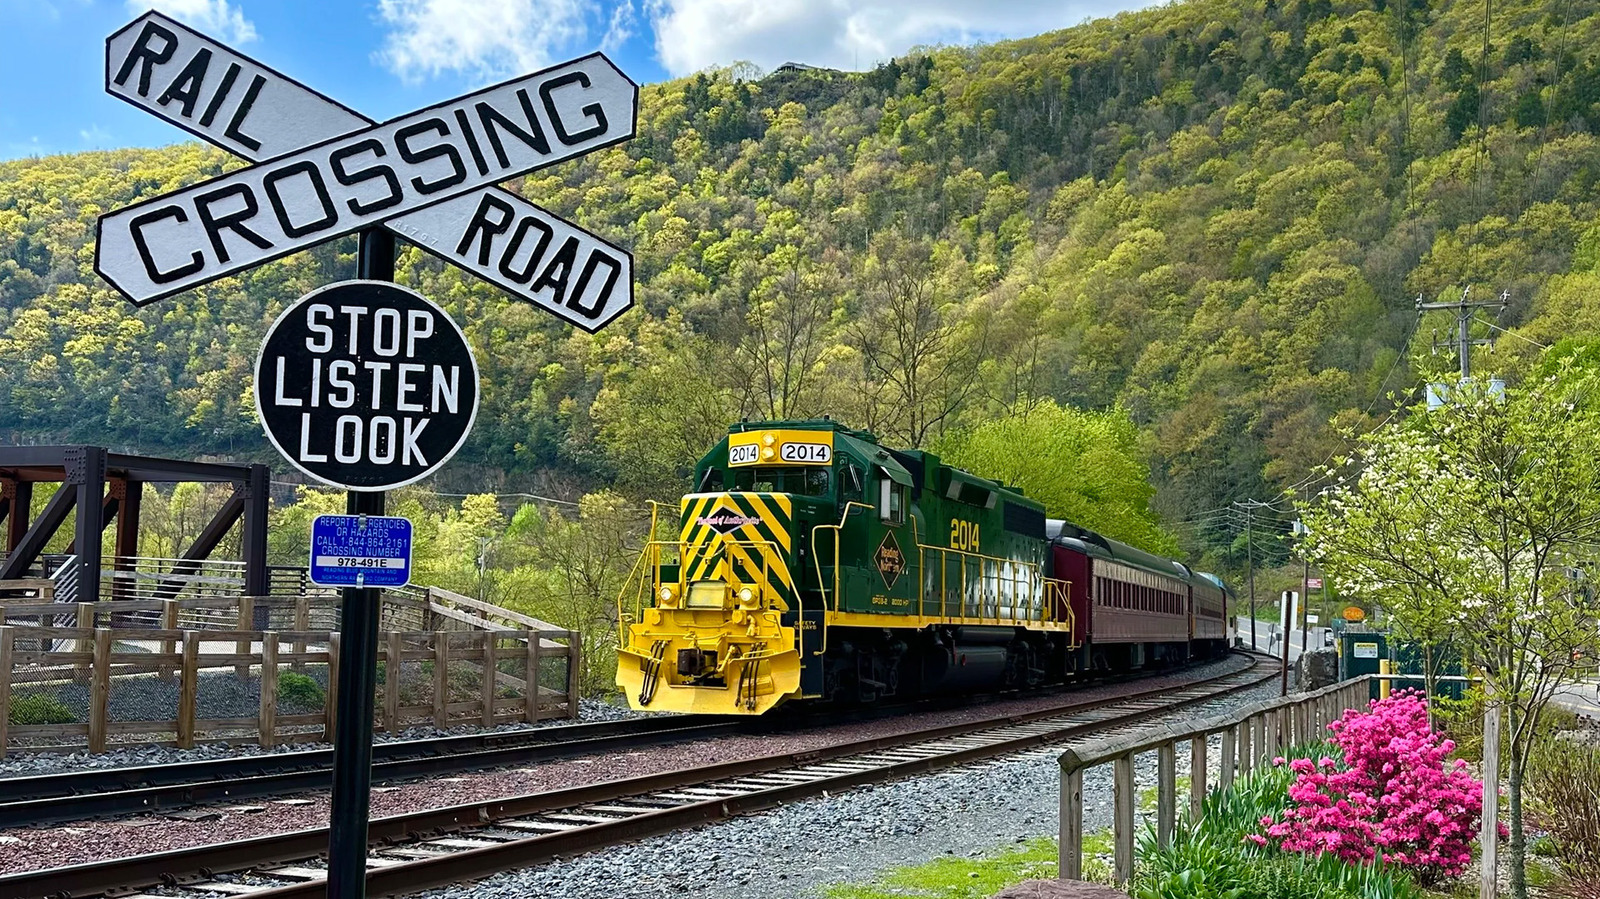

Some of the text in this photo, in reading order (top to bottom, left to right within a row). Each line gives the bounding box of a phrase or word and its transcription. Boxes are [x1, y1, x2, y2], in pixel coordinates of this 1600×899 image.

[114, 20, 267, 152] RAIL
[128, 71, 609, 284] CROSSING
[456, 192, 621, 319] ROAD
[305, 303, 434, 358] STOP
[275, 356, 460, 414] LISTEN
[300, 412, 431, 466] LOOK
[732, 446, 757, 462] 2014
[785, 445, 827, 461] 2014
[320, 517, 406, 529] REPORT EERGENCIES
[336, 527, 389, 538] OR HAZARDS
[950, 518, 980, 552] 2014
[317, 536, 337, 546] CALL
[321, 545, 400, 557] CROSSING NUMBER
[337, 557, 388, 568] 978-491E
